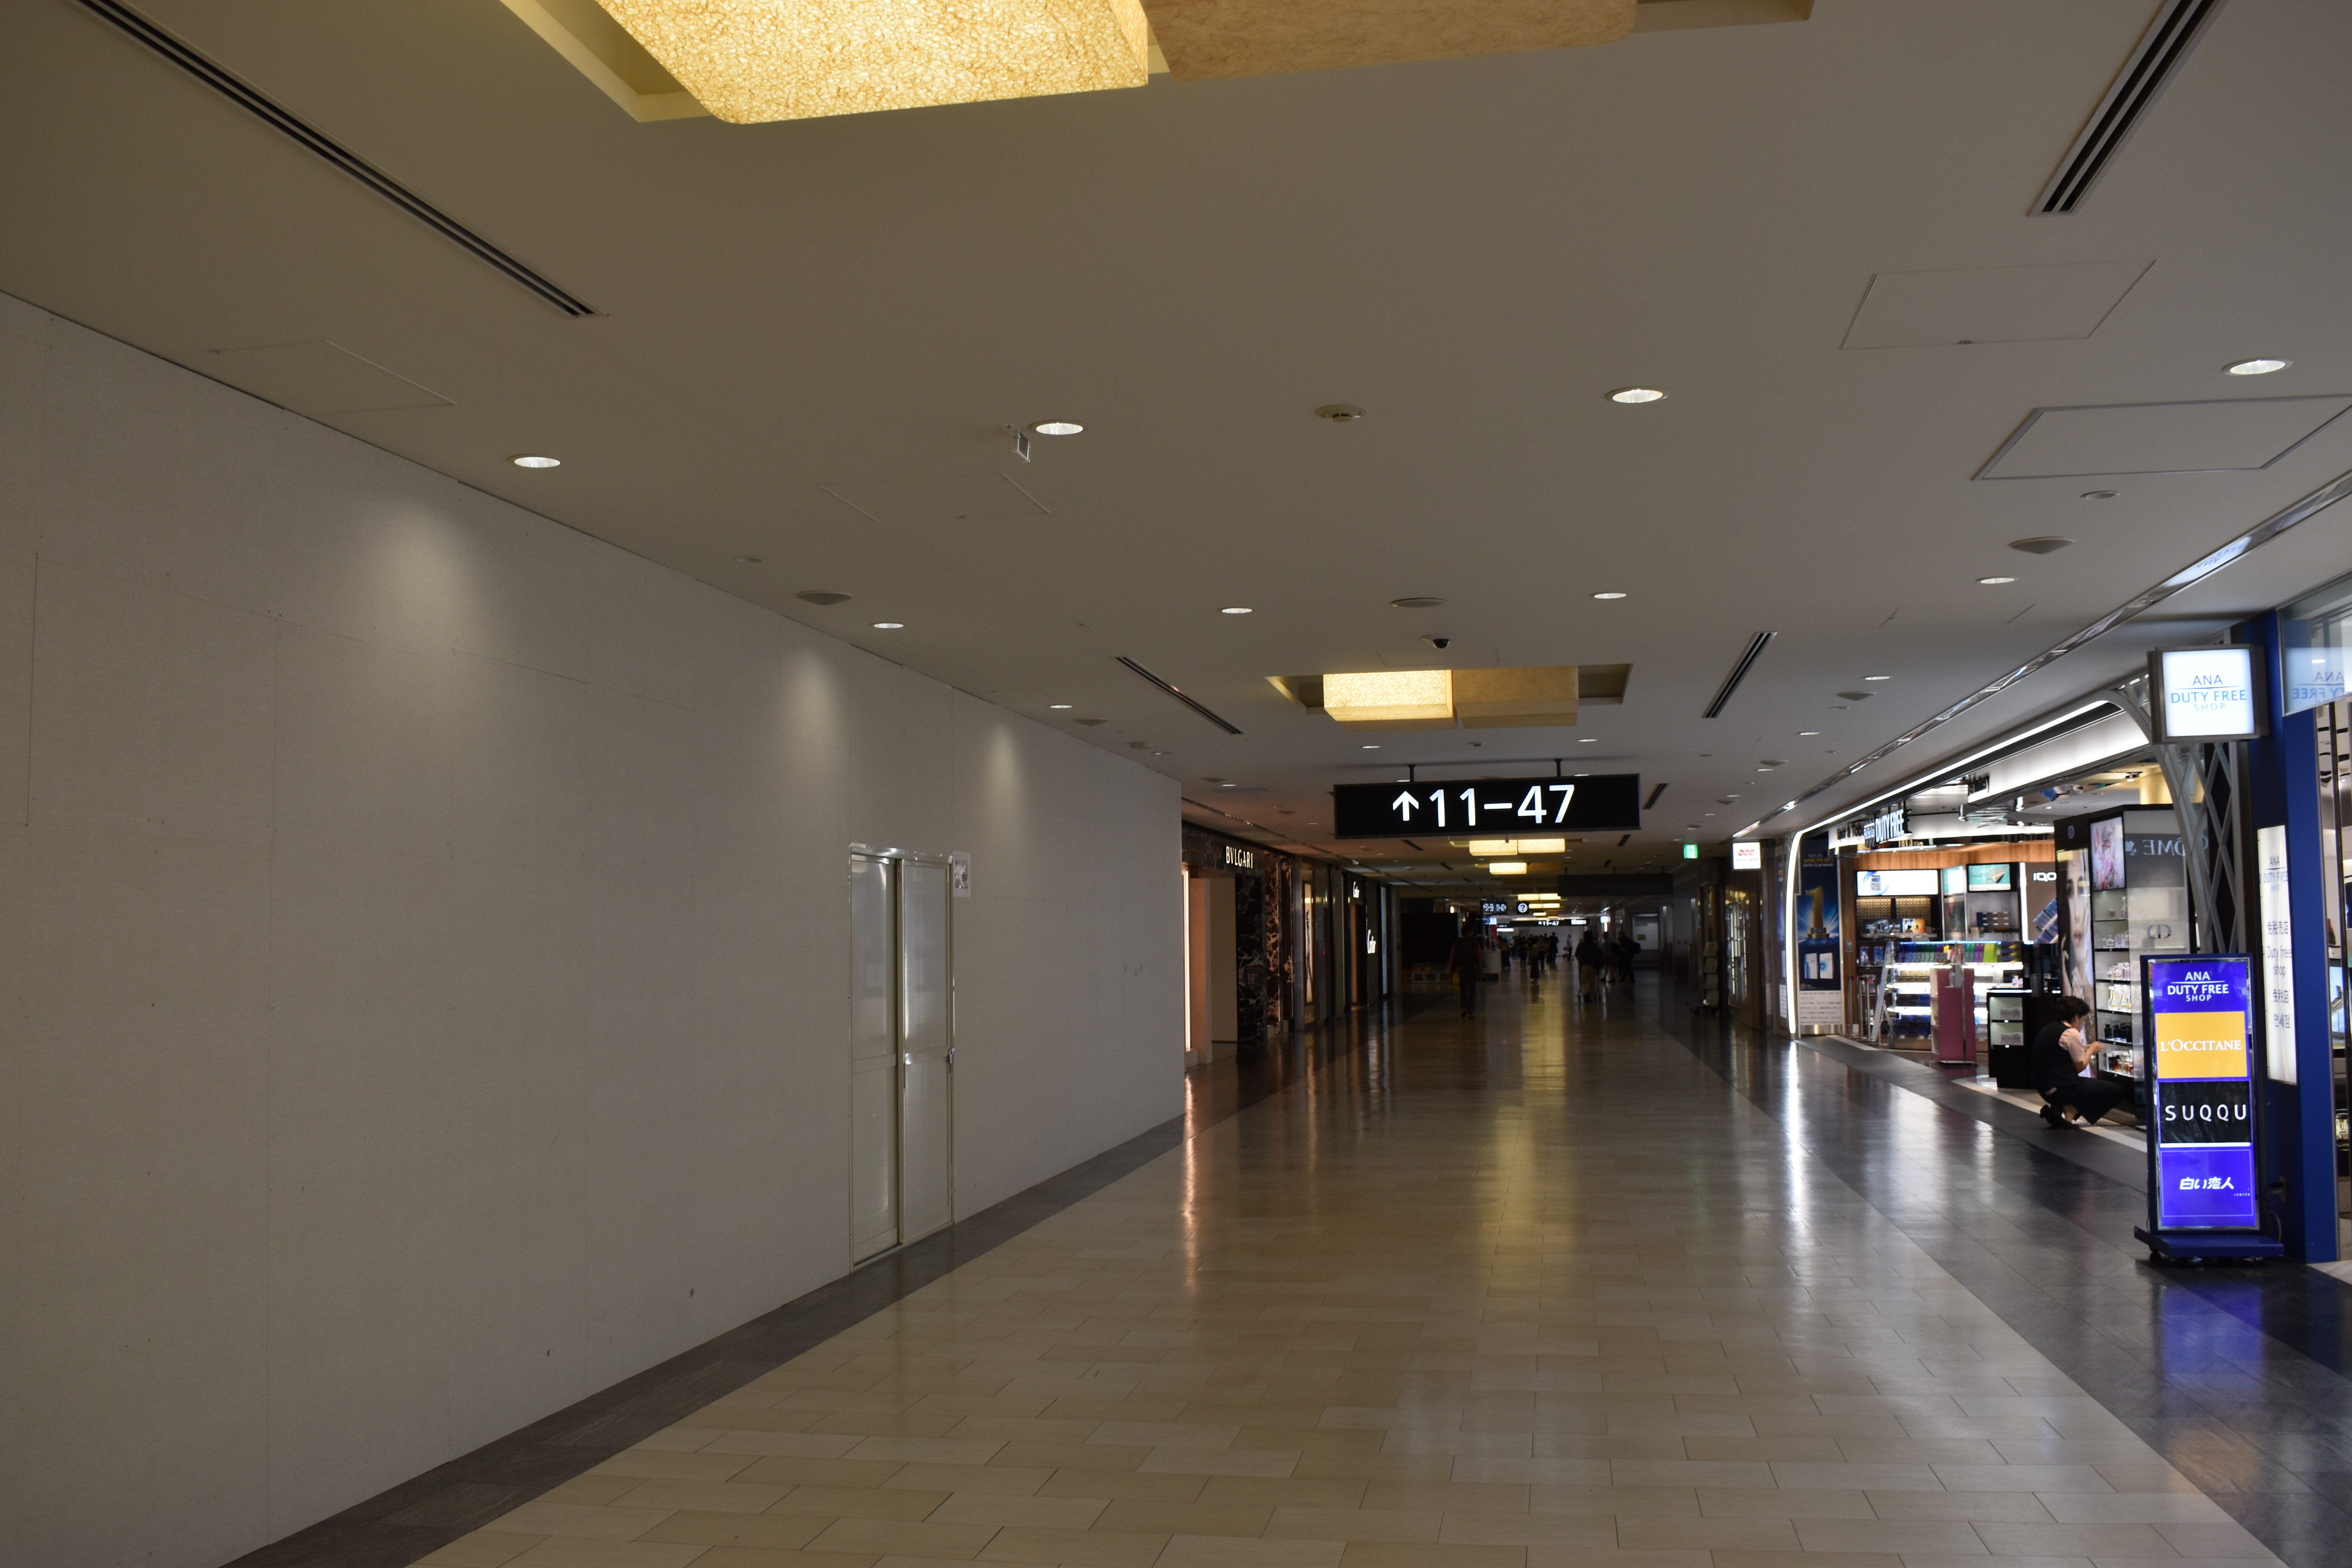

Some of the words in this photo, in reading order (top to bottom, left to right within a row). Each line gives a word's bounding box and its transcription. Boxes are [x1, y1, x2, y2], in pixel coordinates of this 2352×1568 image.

[2193, 675, 2223, 686] ANA
[2171, 692, 2209, 703] DUTY
[2214, 690, 2247, 701] FREE
[2194, 703, 2225, 711] SHOP
[1430, 784, 1575, 827] 11-47
[1875, 814, 1890, 842] DUTY
[1890, 809, 1904, 838] FREE
[1226, 846, 1253, 869] BVLGARI
[2270, 856, 2280, 866] ANA
[2033, 872, 2057, 882] IQO
[2263, 872, 2276, 884] DUTY
[2267, 946, 2278, 961] Duty
[2280, 945, 2292, 958] free
[2185, 971, 2211, 981] ANA
[2273, 963, 2286, 978] shop
[2167, 985, 2199, 995] DUTY
[2201, 984, 2229, 994] FREE
[2160, 1039, 2242, 1052] L'OCCITANE
[2165, 1104, 2247, 1122] SUQQU
[2179, 1176, 2234, 1190] 白い恋人
